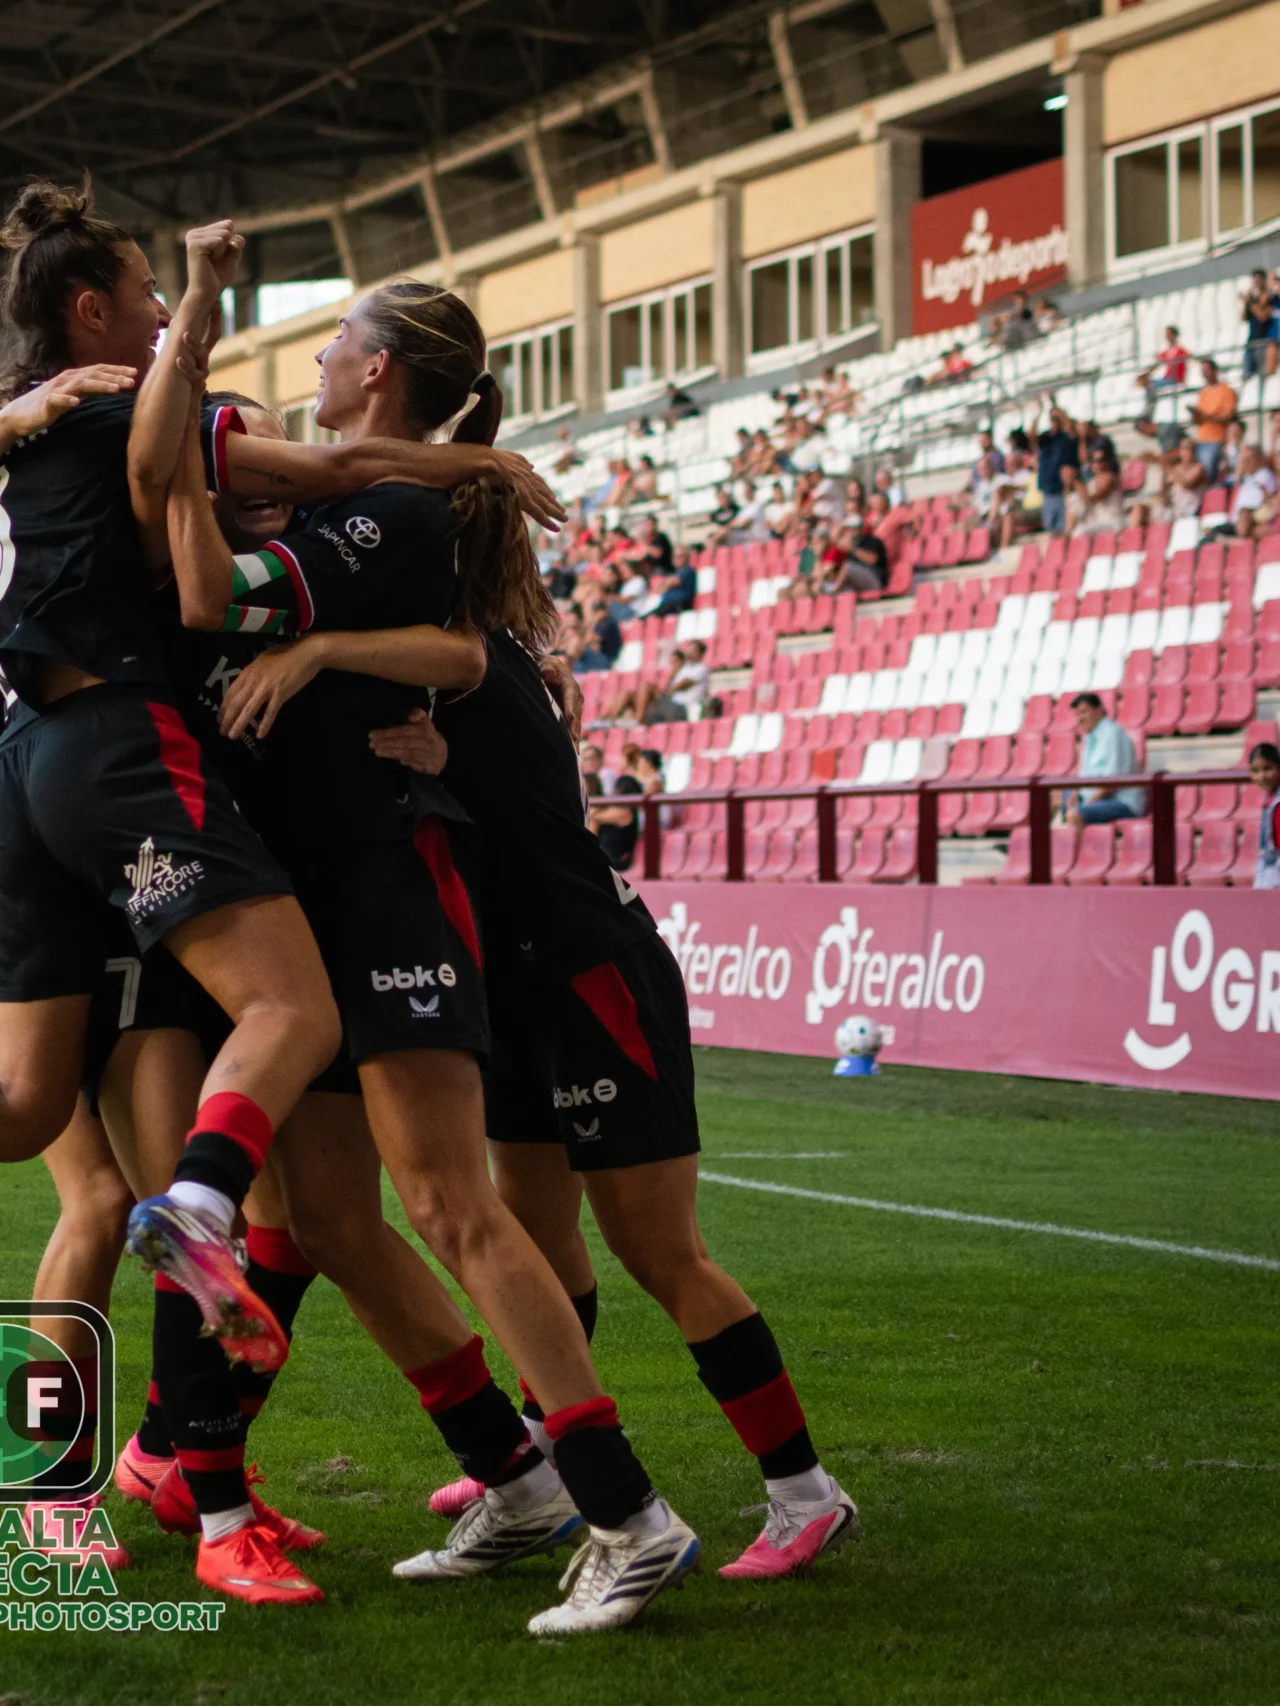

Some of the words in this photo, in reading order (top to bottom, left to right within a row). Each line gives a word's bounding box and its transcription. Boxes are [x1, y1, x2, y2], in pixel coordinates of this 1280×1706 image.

[317, 523, 361, 574] JAPINCAR
[105, 956, 142, 1029] 7
[371, 965, 437, 992] bbk
